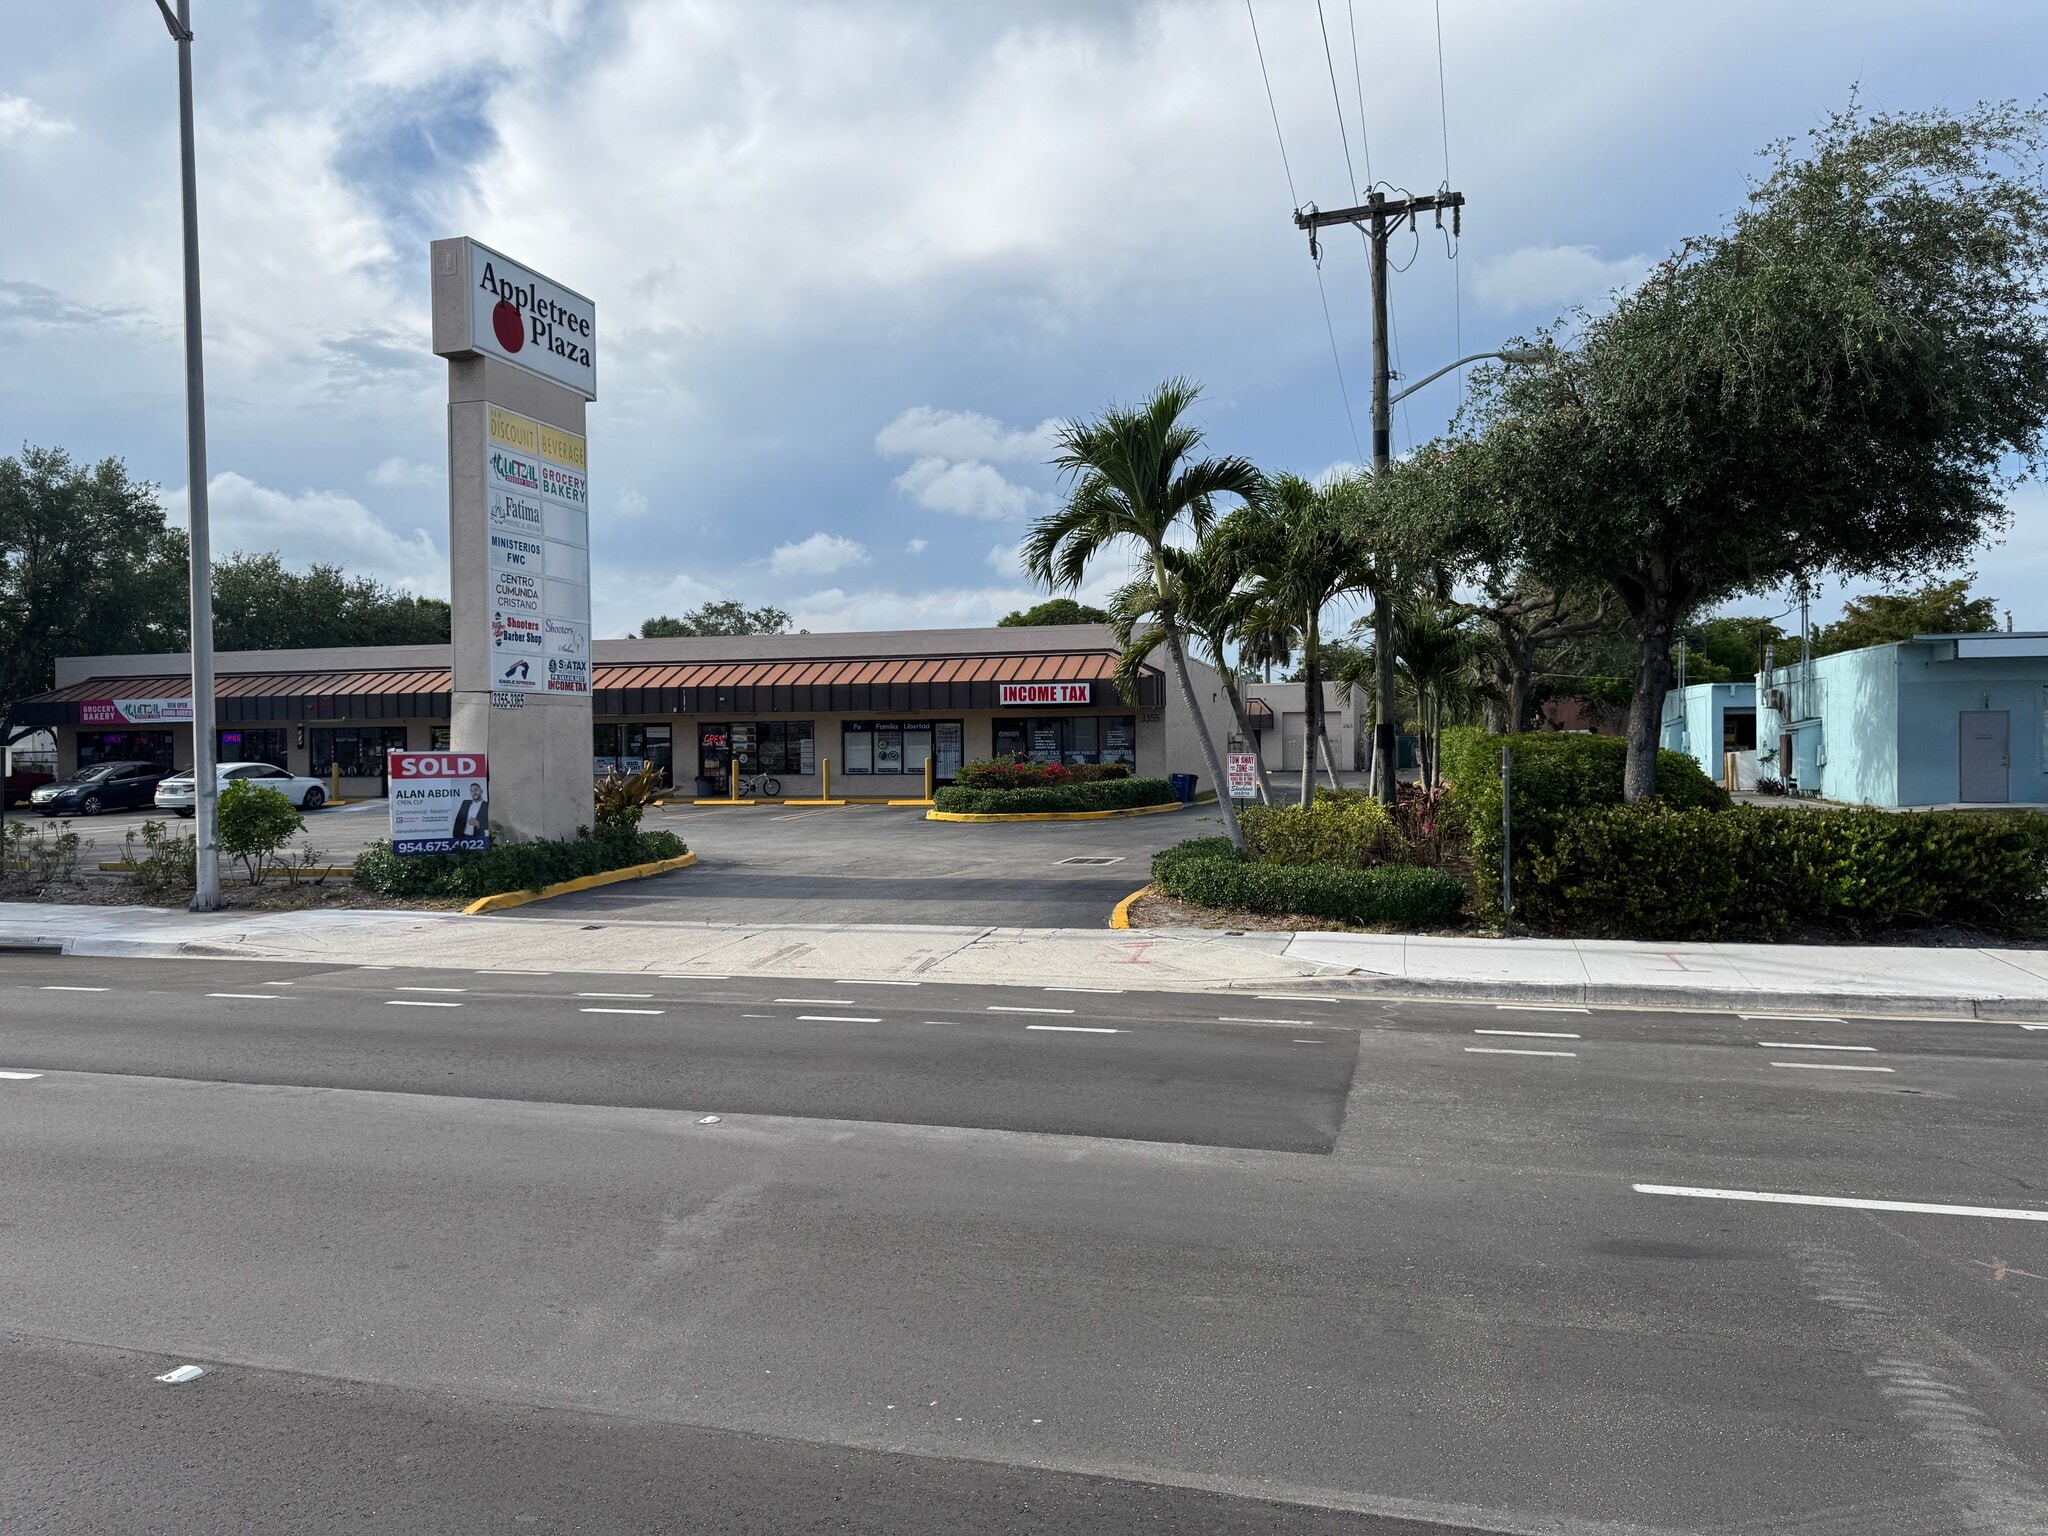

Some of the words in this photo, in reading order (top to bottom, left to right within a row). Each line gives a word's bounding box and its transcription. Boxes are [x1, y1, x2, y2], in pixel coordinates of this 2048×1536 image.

[480, 262, 590, 337] Appletree
[530, 315, 591, 368] Plaza
[491, 418, 533, 448] DISCOUNT
[542, 436, 584, 464] BEVERAGE
[542, 468, 585, 490] GROCERY
[543, 480, 585, 503] BAKERY
[505, 496, 540, 523] Fatima
[491, 536, 541, 555] MINISTERIOS
[507, 552, 526, 565] FWC
[500, 573, 535, 587] CENTRO
[495, 584, 539, 600] CUMUNIDA
[497, 596, 538, 611] CRISTANO
[506, 616, 540, 631] Shooters
[545, 619, 574, 635] Shooters
[503, 630, 525, 643] Barber
[526, 632, 542, 646] Shop
[547, 680, 575, 692] INCOME
[574, 682, 588, 692] TAX
[492, 692, 525, 709] 3355-3365
[1003, 686, 1057, 702] INCOME
[1061, 686, 1087, 701] TAX
[82, 705, 115, 713] GROCERY
[83, 713, 115, 721] BAKERY
[1140, 713, 1160, 723] 3355
[903, 722, 930, 730] Libertad
[703, 734, 725, 745] OPEN
[401, 758, 477, 775] SOLD
[1230, 756, 1240, 764] TOW
[1241, 756, 1254, 764] AWAY
[1236, 764, 1248, 772] ZONE
[396, 789, 425, 799] ALAN
[427, 789, 461, 798] ABDIN
